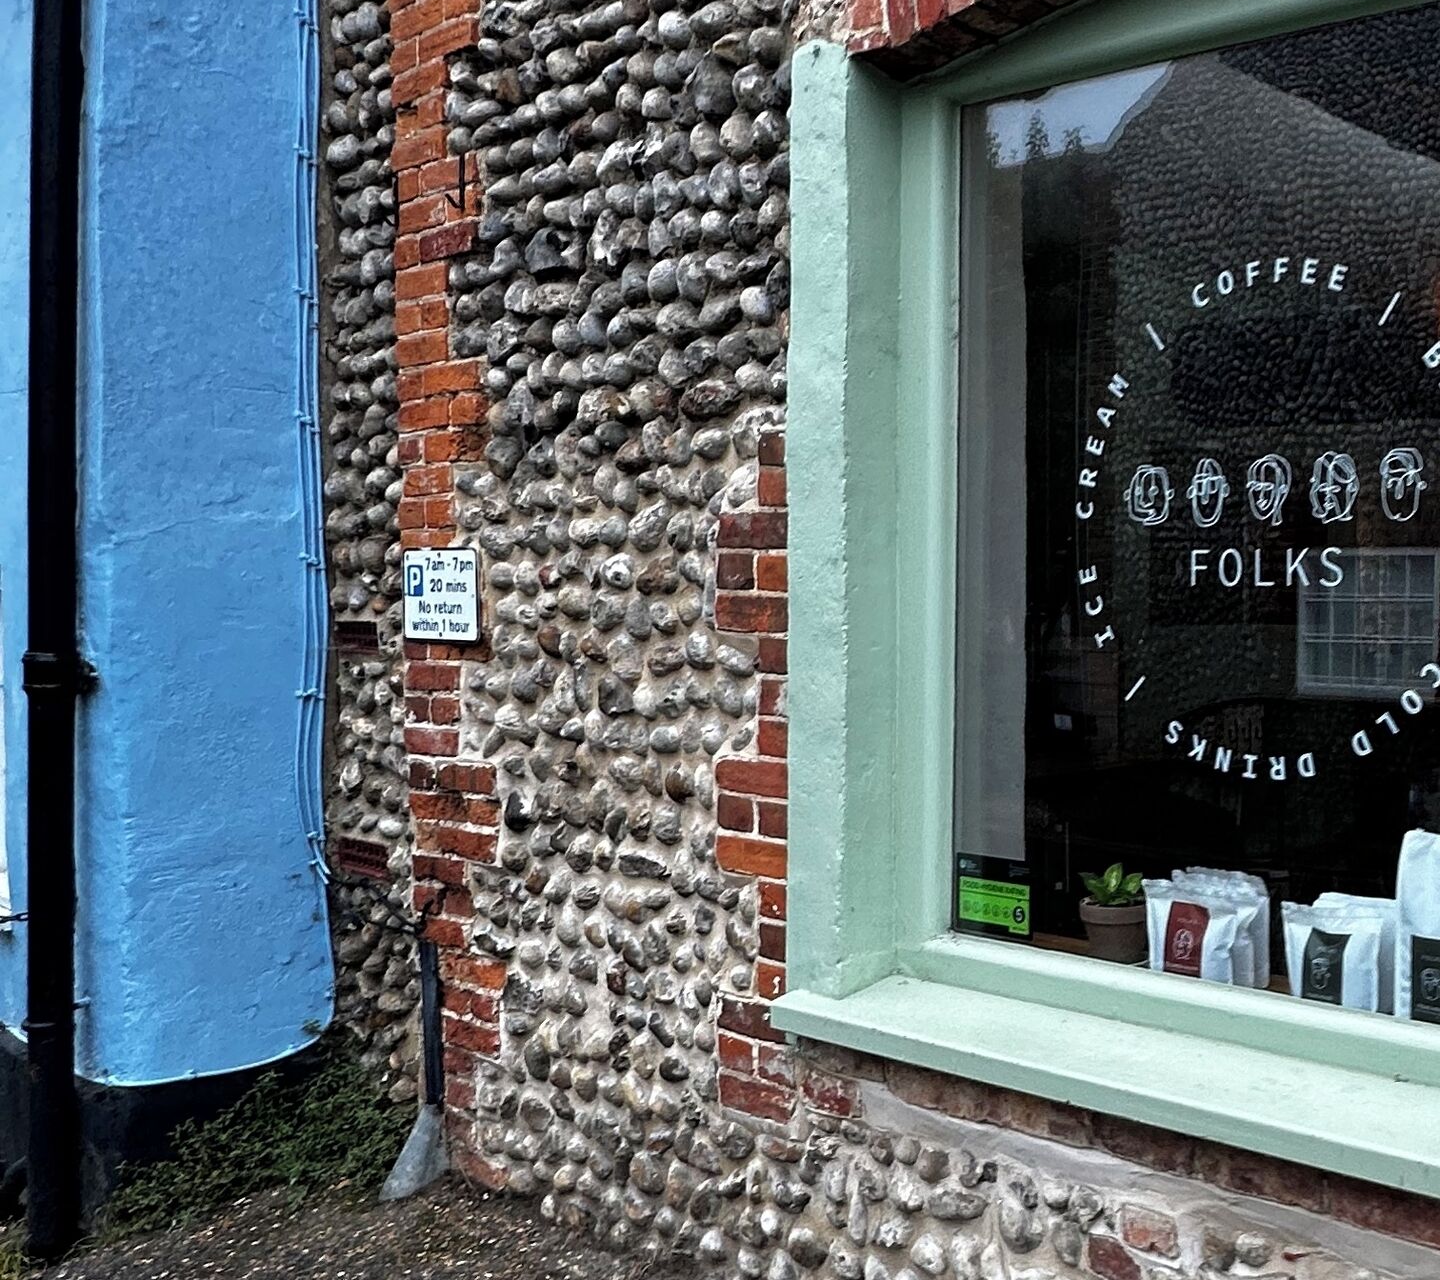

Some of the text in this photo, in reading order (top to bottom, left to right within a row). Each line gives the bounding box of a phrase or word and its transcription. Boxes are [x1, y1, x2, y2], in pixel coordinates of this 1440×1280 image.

[1191, 256, 1349, 308] COFFEE
[1075, 373, 1130, 519] CREAM
[409, 567, 421, 595] P
[424, 557, 445, 572] 7am
[452, 557, 474, 573] 7pm
[1190, 546, 1344, 588] FOLKS
[429, 578, 467, 593] 20 mins
[418, 600, 463, 615] No return
[1078, 565, 1115, 649] ICE
[412, 618, 439, 632] within
[449, 619, 470, 633] hour
[1164, 720, 1316, 781] DRINKS
